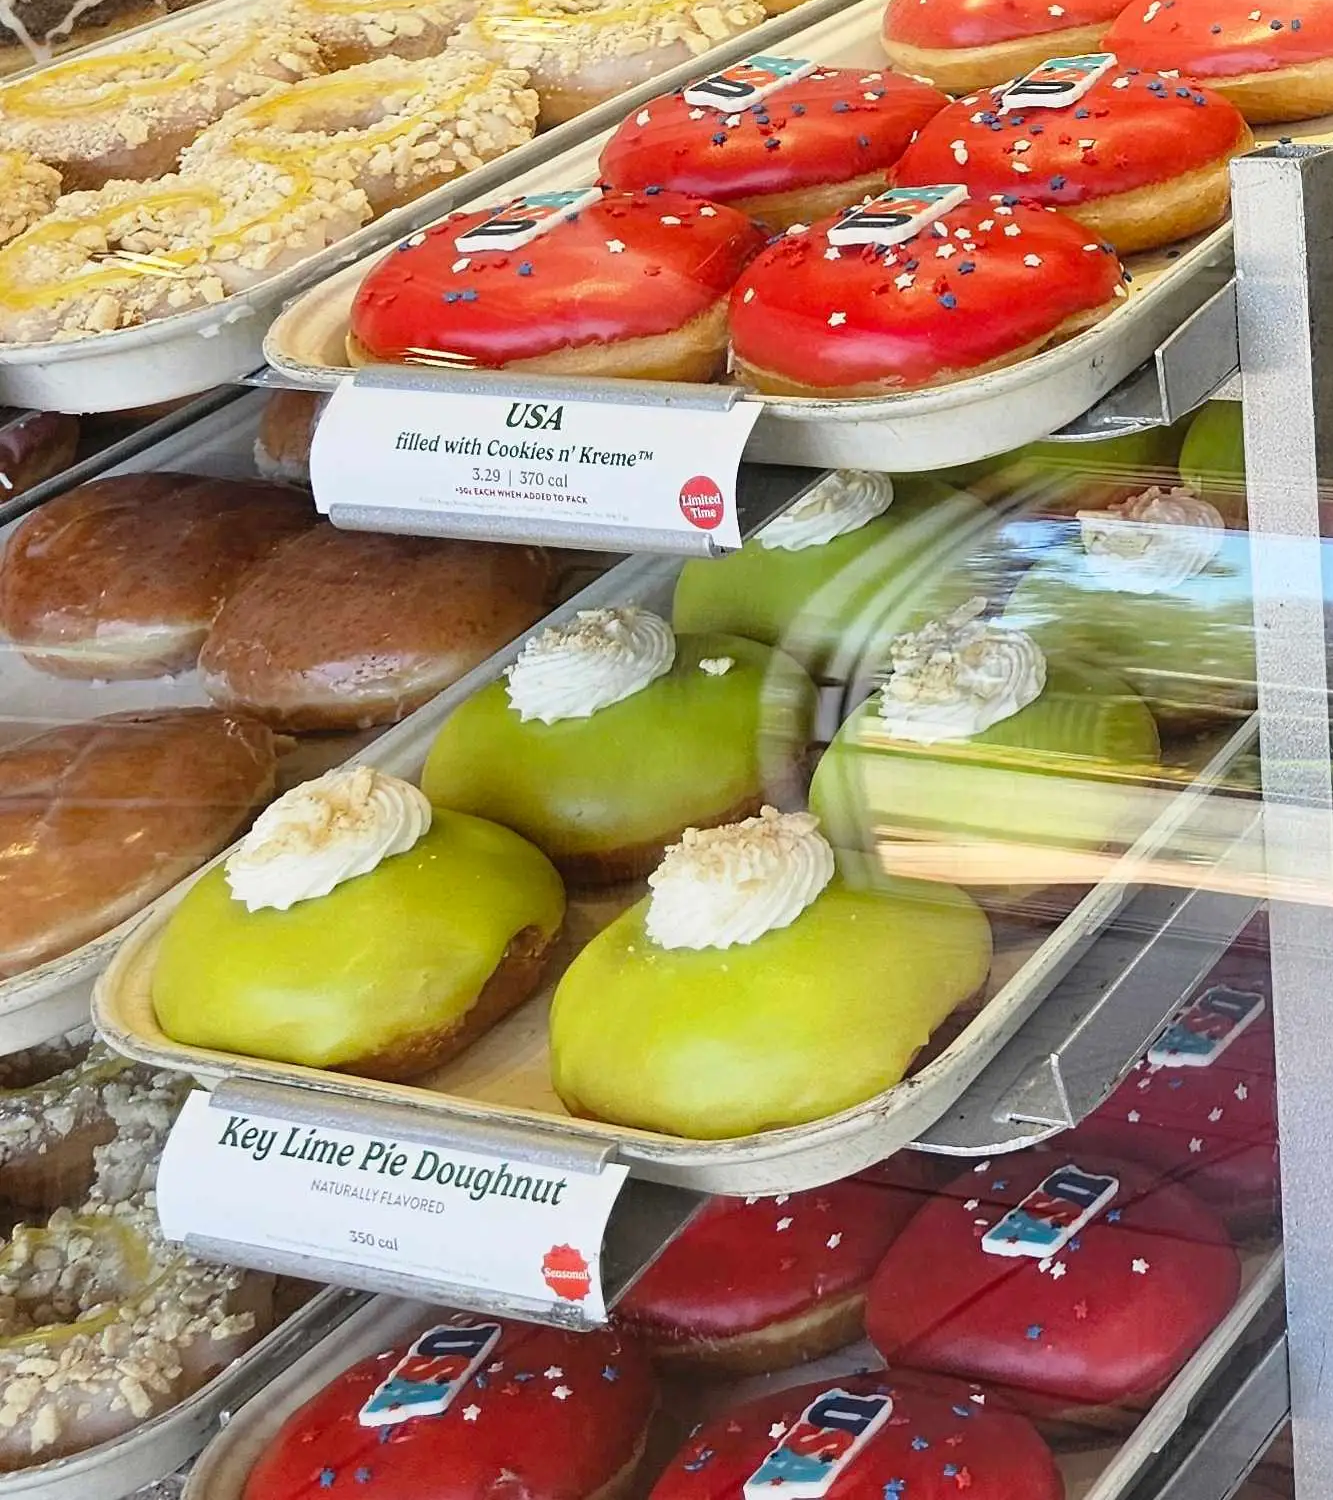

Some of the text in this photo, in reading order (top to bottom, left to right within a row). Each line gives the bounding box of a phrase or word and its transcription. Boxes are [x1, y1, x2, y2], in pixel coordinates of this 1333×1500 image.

[506, 403, 562, 431] USA
[395, 432, 440, 454] filled
[444, 436, 481, 456] with
[487, 440, 554, 463] Cookies
[472, 468, 500, 482] 3.29
[520, 471, 544, 486] 370
[548, 474, 568, 488] cal
[473, 488, 495, 497] EACH
[498, 490, 521, 499] WHEN
[523, 492, 551, 501] ADDED
[553, 494, 564, 502] TO
[566, 495, 588, 504] PACK
[681, 492, 721, 506] Limited
[690, 507, 717, 518] Time
[218, 1115, 567, 1206] Key Lime Pie Doughnut
[310, 1179, 445, 1215] NATURALLY FLAVORED
[349, 1230, 398, 1251] 350 cal
[544, 1268, 588, 1280] Seasonal
